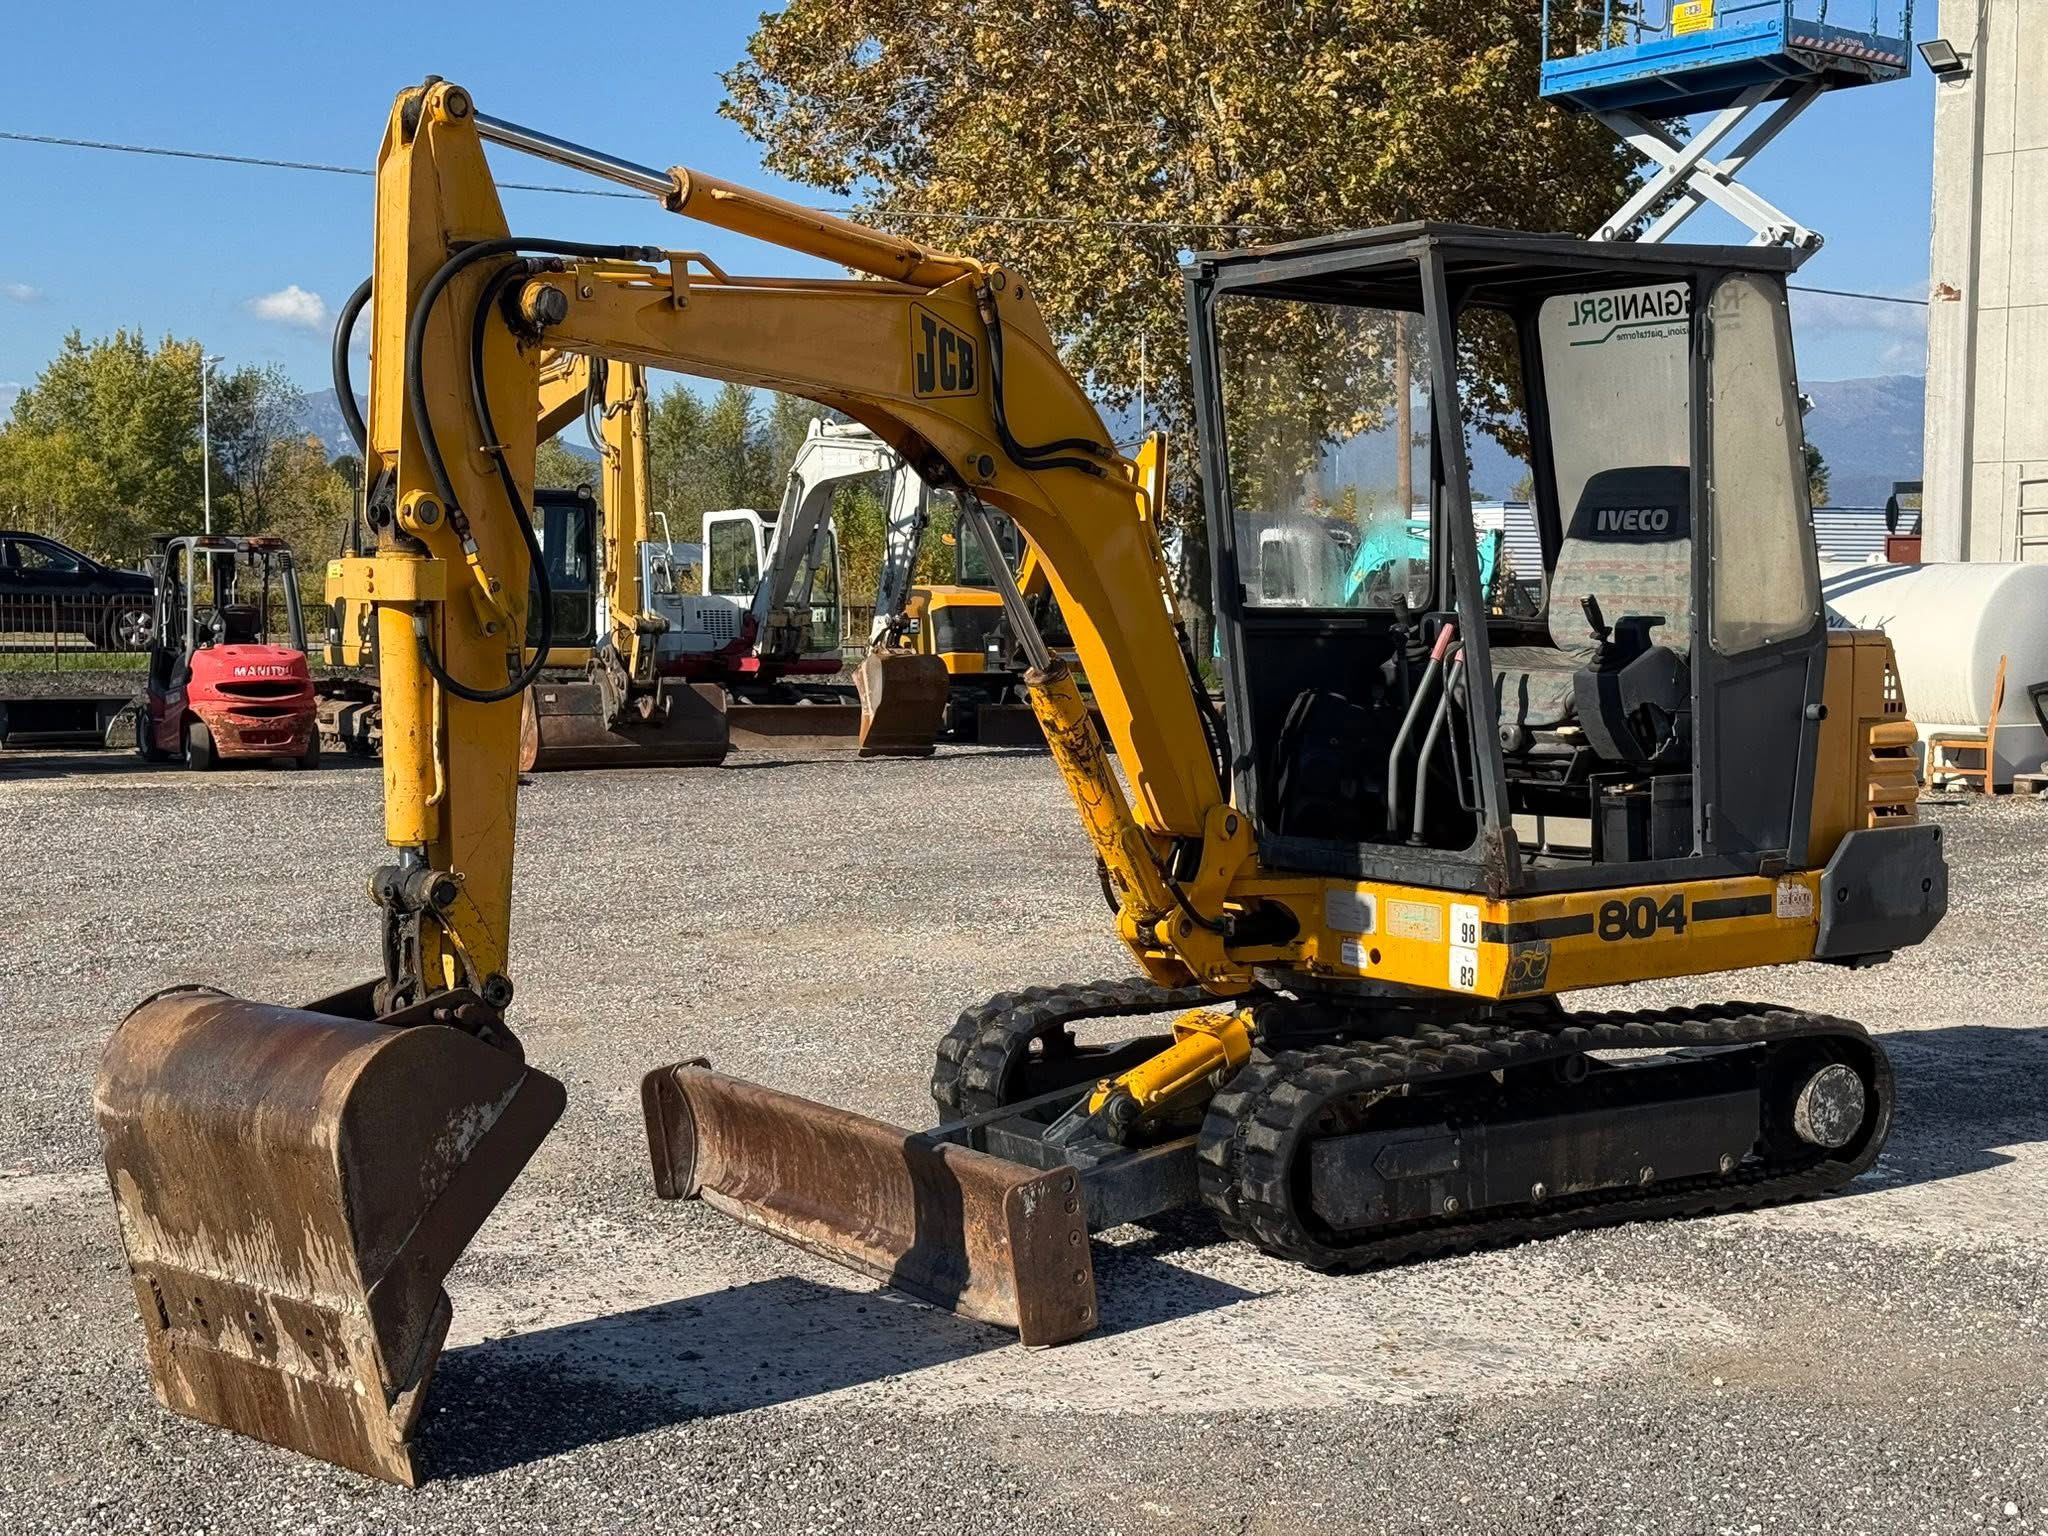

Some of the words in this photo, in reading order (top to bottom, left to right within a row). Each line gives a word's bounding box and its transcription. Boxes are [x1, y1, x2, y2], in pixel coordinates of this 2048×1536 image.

[917, 313, 974, 392] JCB
[1597, 509, 1669, 531] IVECO
[1598, 894, 1687, 942] 804
[1461, 923, 1476, 944] 98
[1460, 966, 1475, 987] 83
